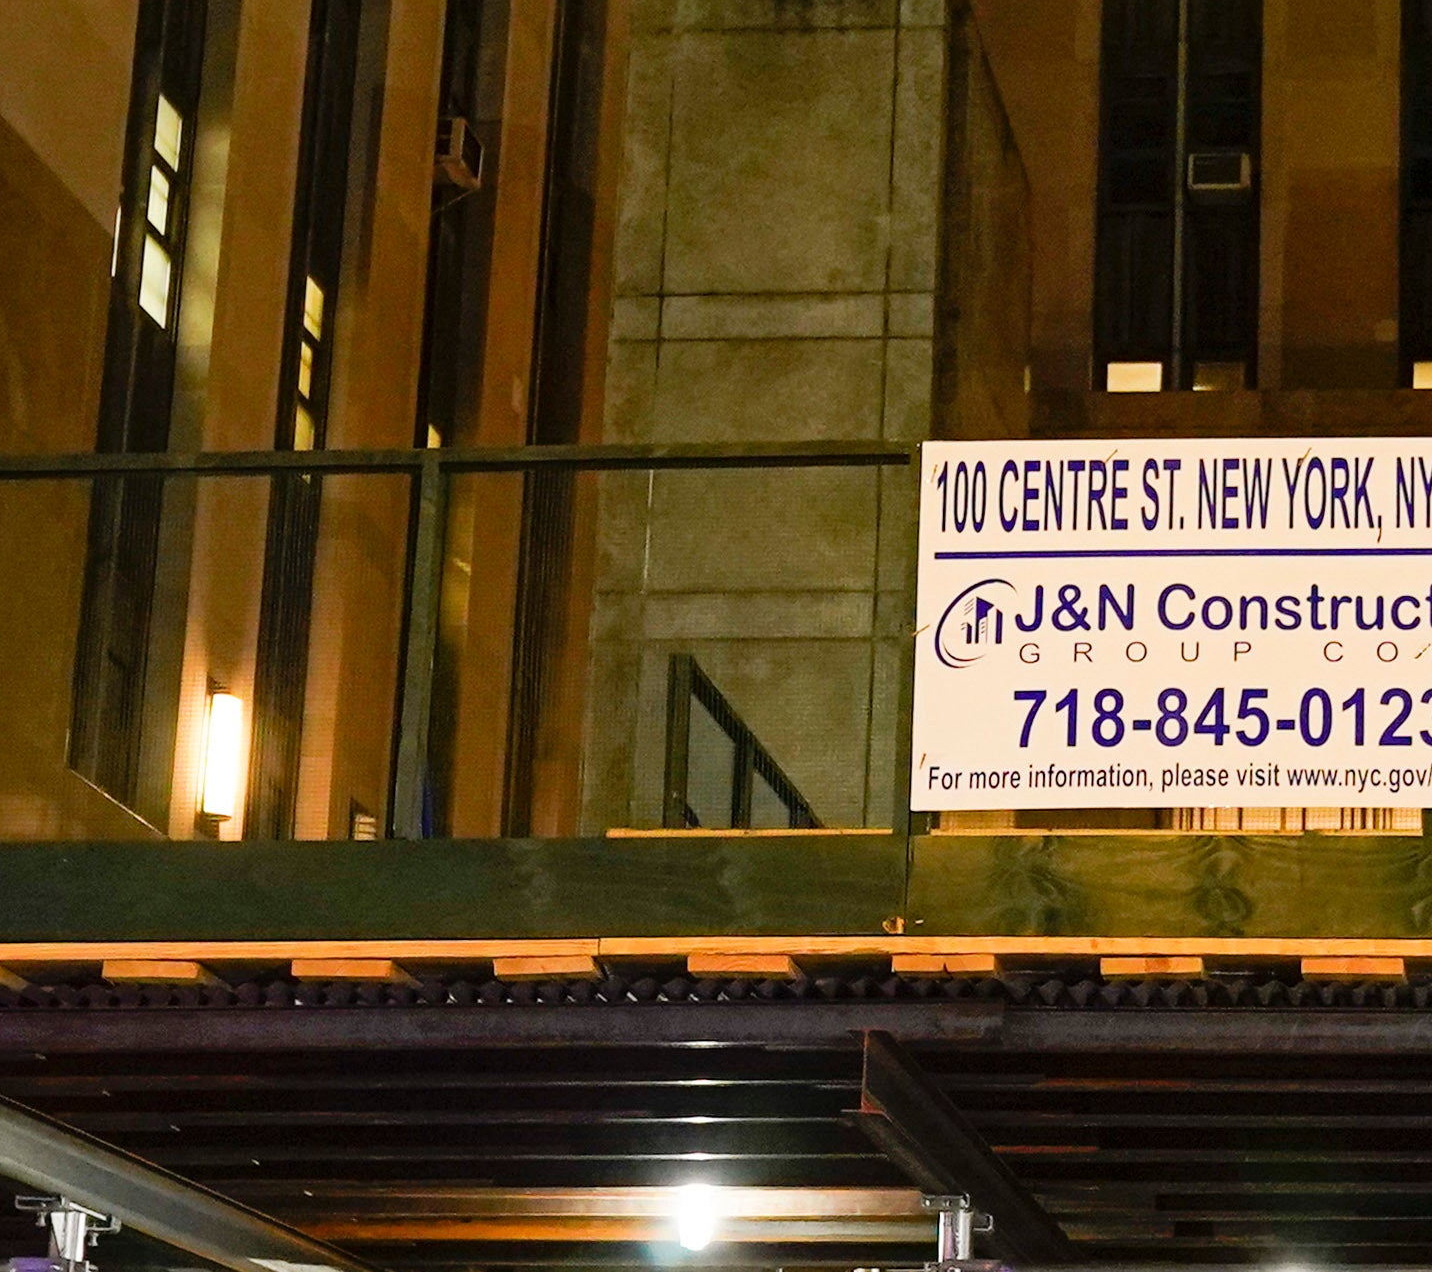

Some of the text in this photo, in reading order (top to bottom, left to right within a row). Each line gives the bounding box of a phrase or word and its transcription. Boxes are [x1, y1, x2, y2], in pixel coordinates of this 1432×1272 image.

[937, 459, 987, 533] 100
[999, 458, 1130, 532] CENTRE
[1141, 458, 1185, 531] ST.
[1198, 457, 1272, 529] NEW
[1282, 456, 1382, 538] YORK,
[1015, 583, 1135, 632] J&N
[1019, 641, 1252, 663] GROUP
[928, 766, 962, 790] For
[969, 767, 1021, 790] more
[1028, 763, 1154, 791] information,
[1161, 763, 1229, 792] please
[1237, 763, 1280, 787] visit
